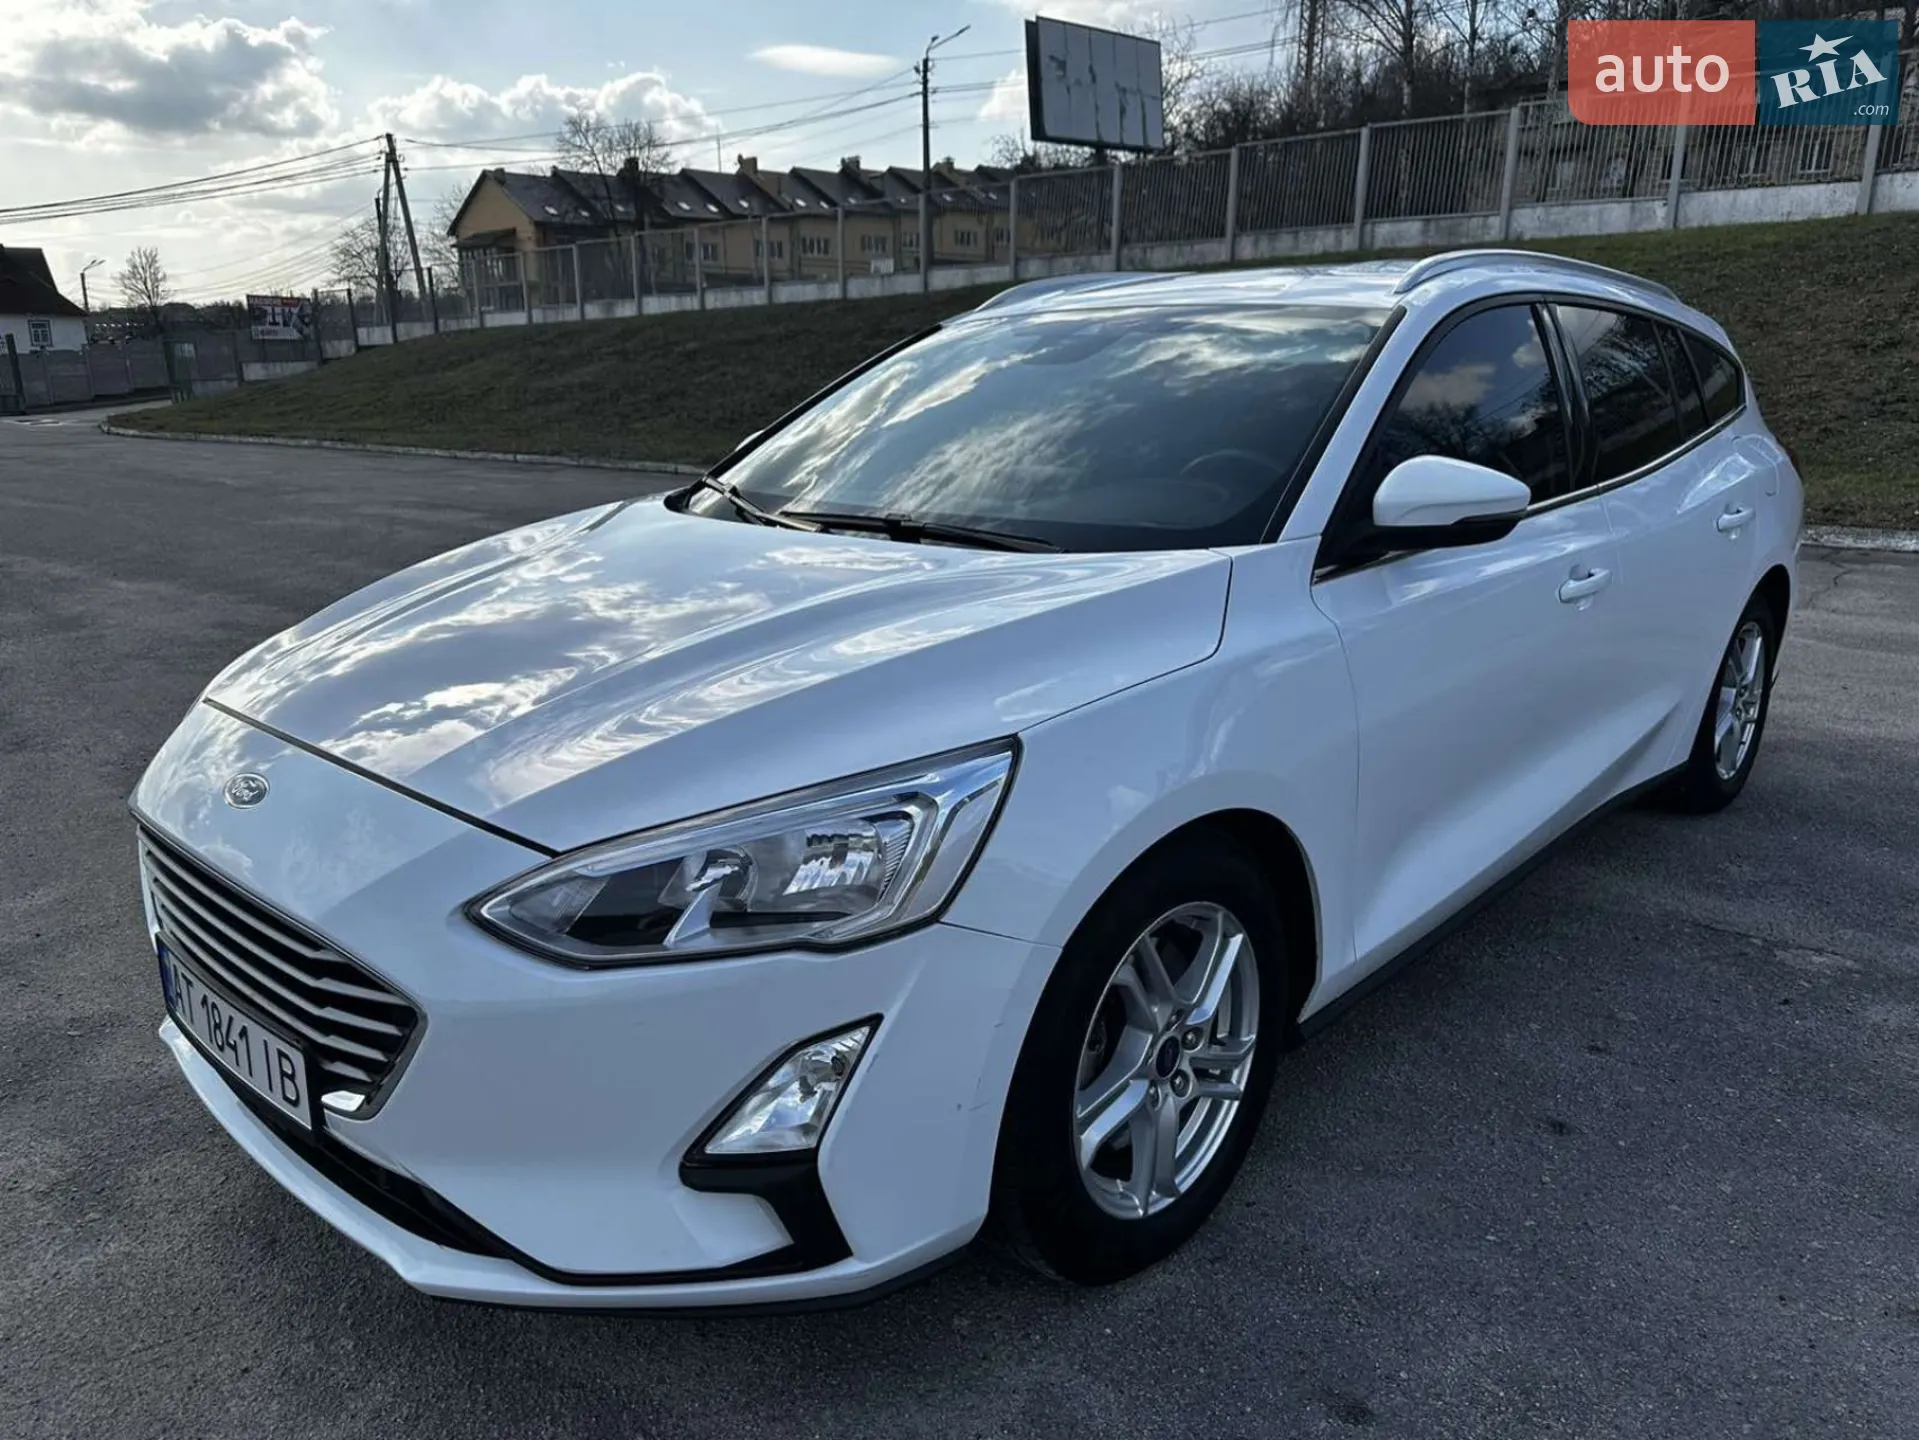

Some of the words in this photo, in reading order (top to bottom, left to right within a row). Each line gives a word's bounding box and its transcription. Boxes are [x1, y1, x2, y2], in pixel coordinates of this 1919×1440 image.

[172, 962, 194, 1026] AT
[200, 993, 253, 1077] 1841
[263, 1038, 300, 1108] IB
